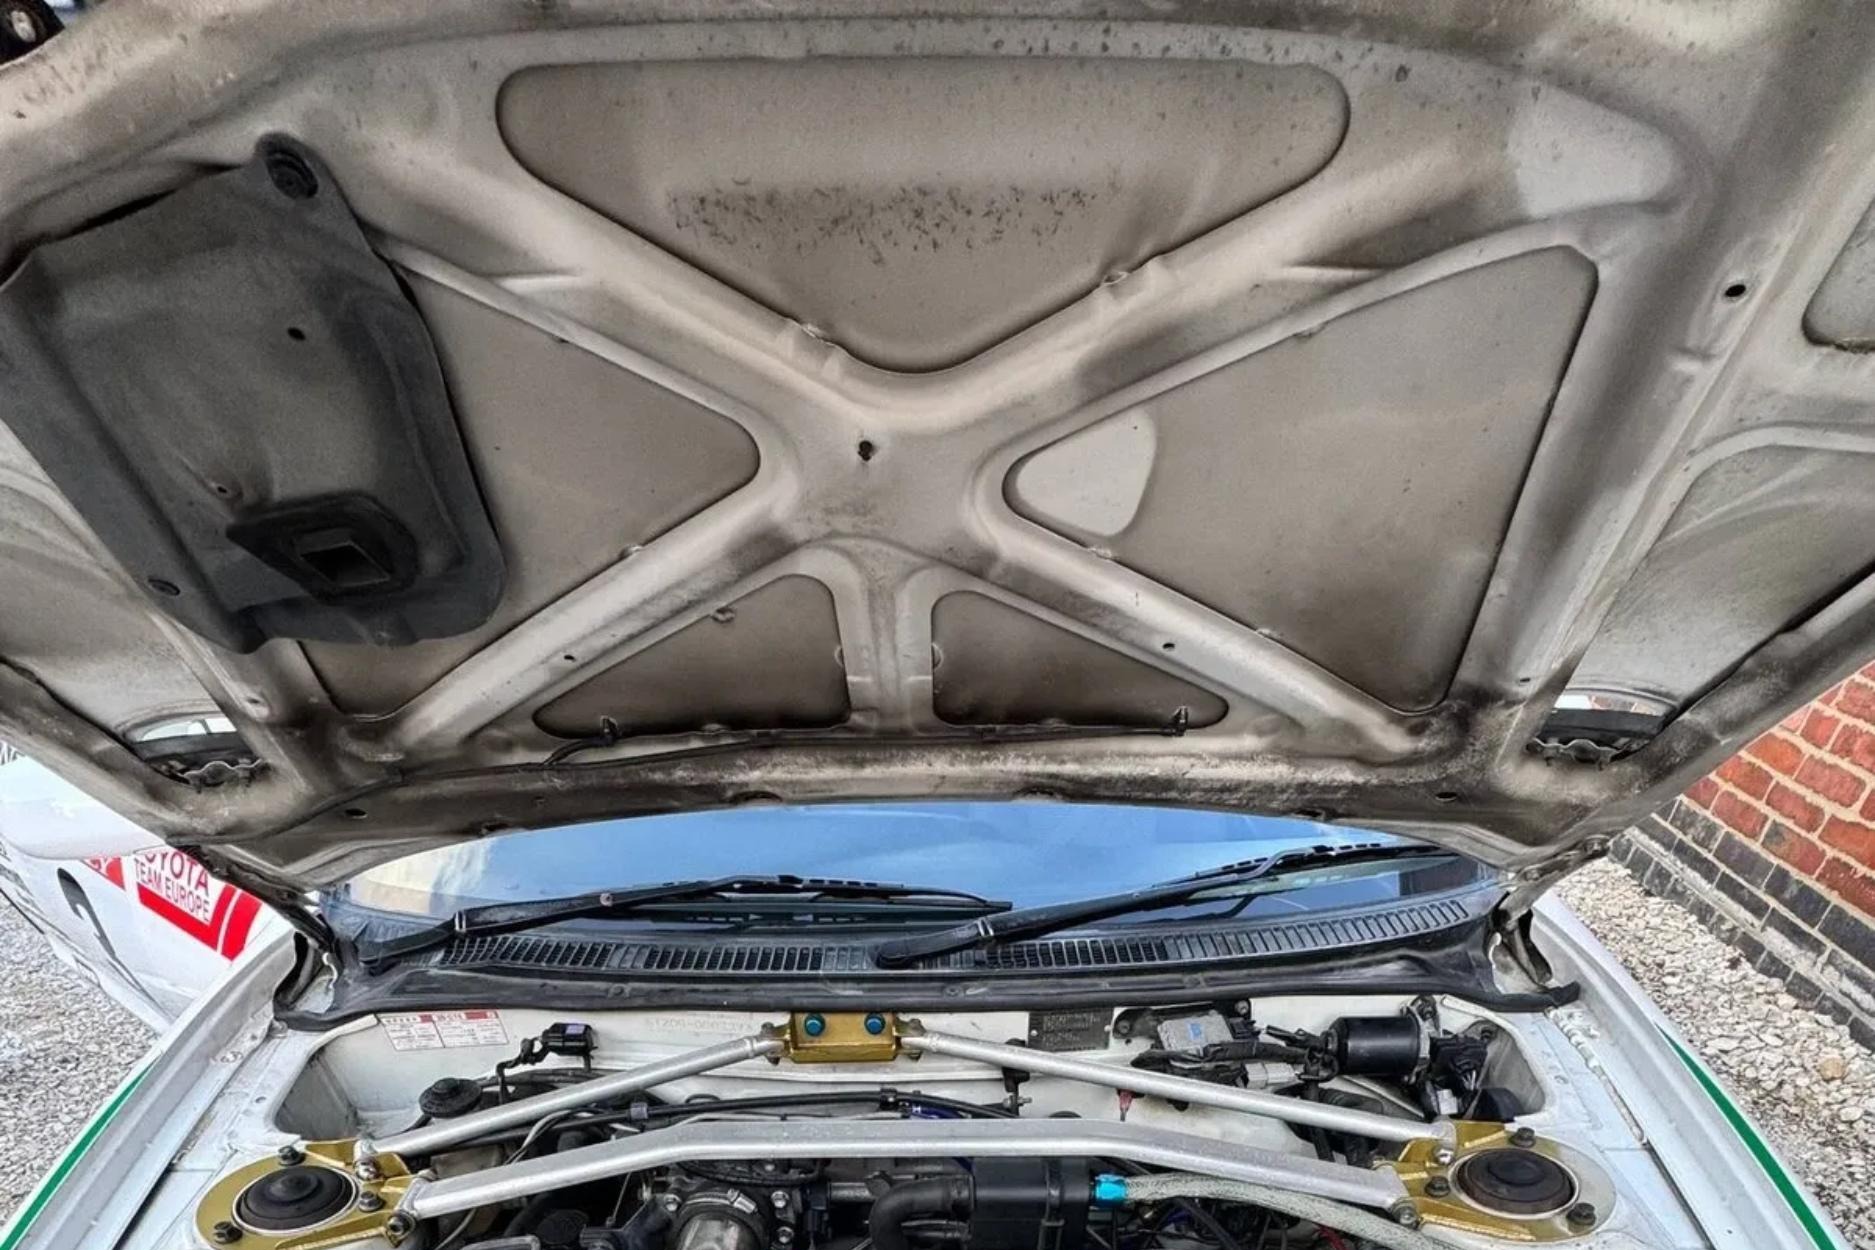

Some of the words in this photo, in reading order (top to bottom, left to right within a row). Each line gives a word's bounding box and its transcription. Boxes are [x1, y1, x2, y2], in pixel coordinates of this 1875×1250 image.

[134, 857, 163, 894] TEAM
[165, 876, 210, 922] EUROPE
[144, 851, 210, 898] YOTA
